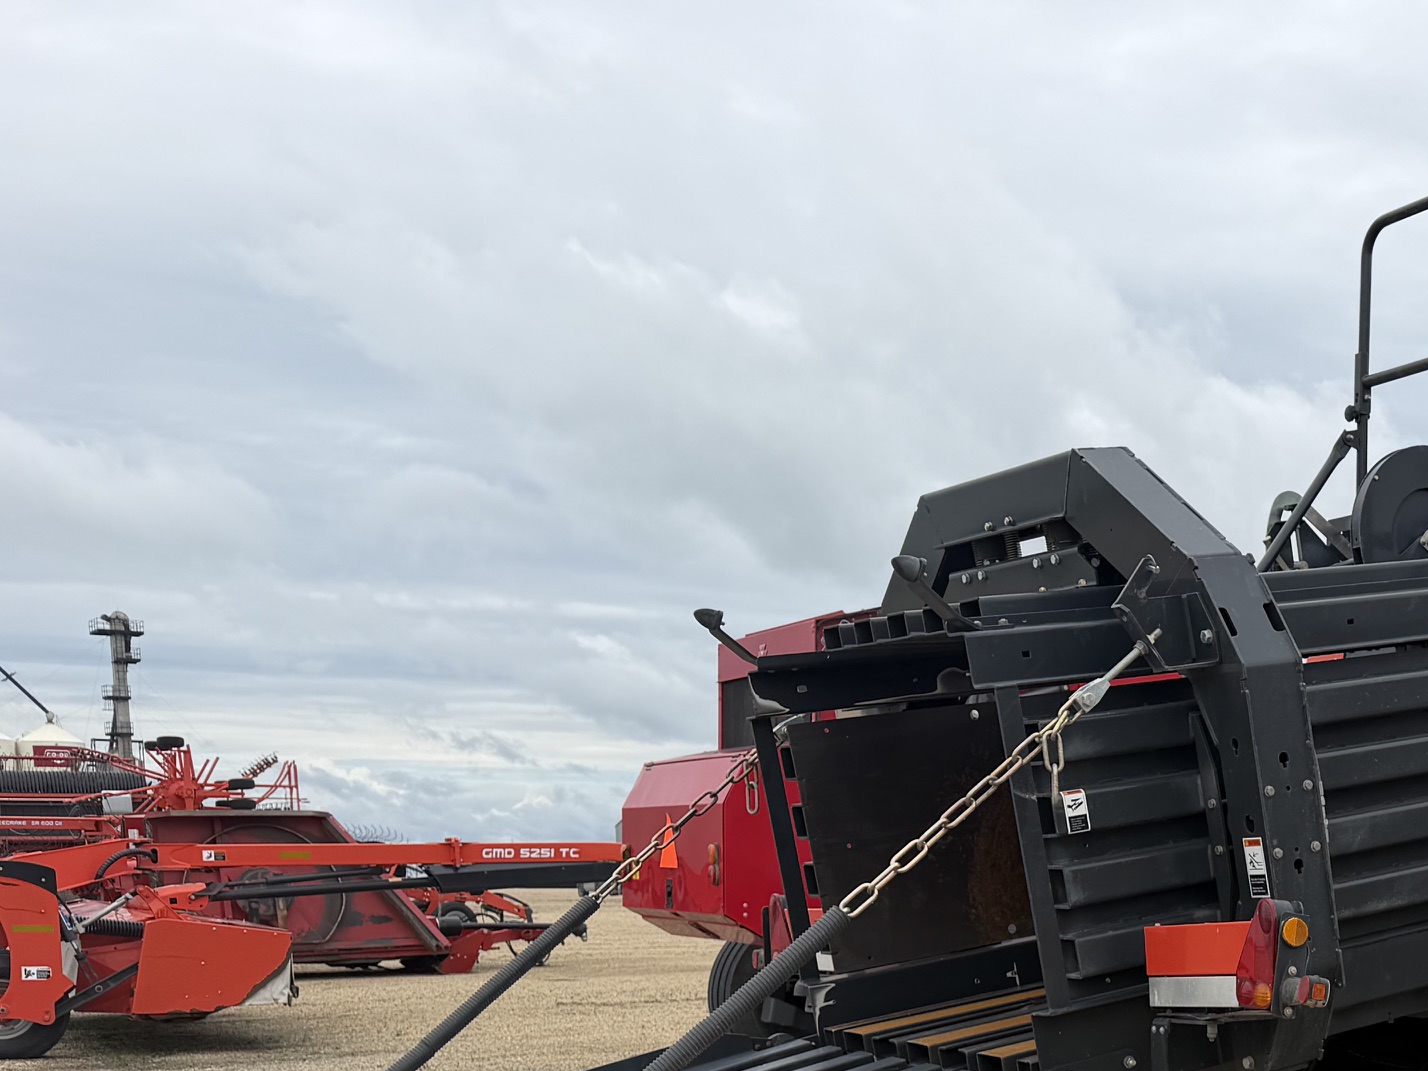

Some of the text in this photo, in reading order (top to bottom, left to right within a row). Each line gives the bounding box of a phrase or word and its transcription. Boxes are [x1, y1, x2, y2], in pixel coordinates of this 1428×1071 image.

[482, 848, 580, 858] GMD 5251 TC
